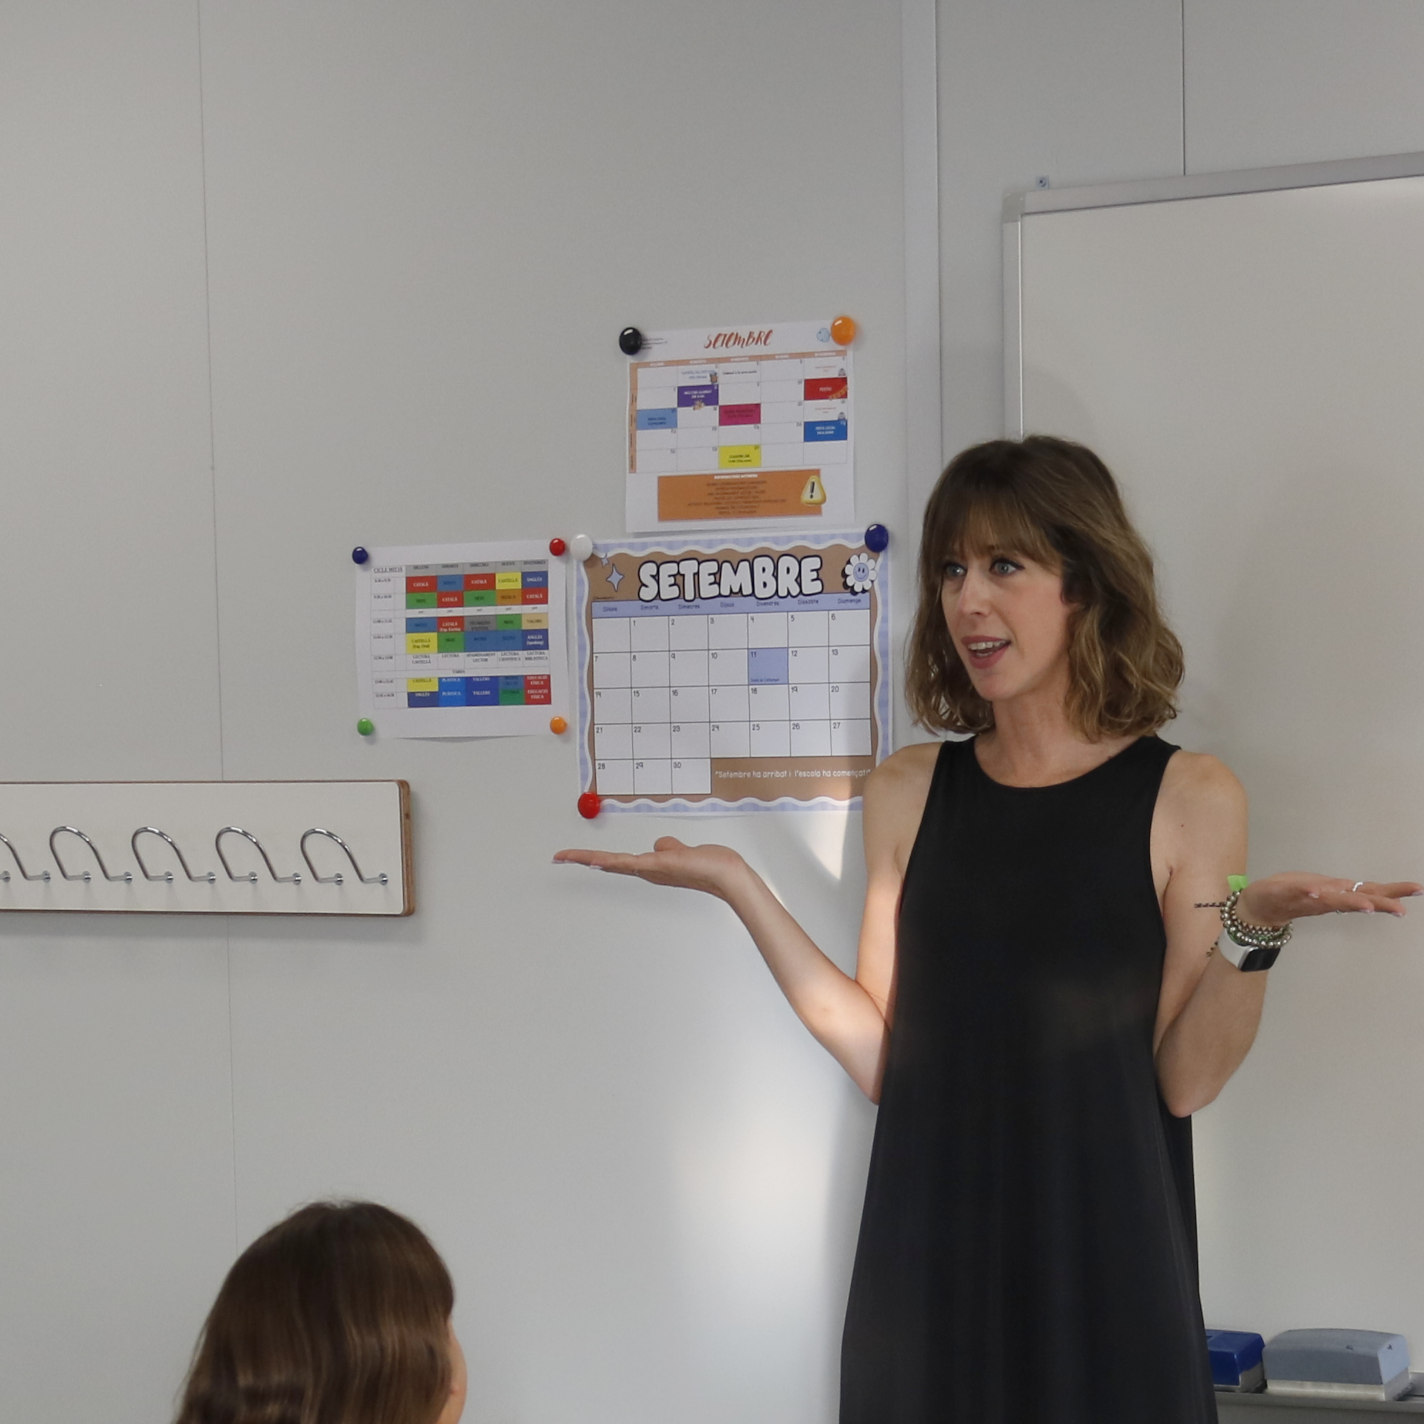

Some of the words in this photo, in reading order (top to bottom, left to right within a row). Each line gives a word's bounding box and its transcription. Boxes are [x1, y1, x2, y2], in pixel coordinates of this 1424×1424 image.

[638, 555, 824, 602] SETEMBRE
[711, 651, 719, 660] 10
[792, 649, 798, 658] 12
[832, 648, 839, 656] 13
[672, 689, 679, 697] 16
[751, 687, 758, 695] 18
[791, 685, 799, 693] 19
[831, 685, 840, 693] 20
[634, 690, 640, 698] 15
[673, 724, 681, 733] 23
[712, 724, 720, 732] 24
[752, 723, 761, 731] 25
[792, 722, 801, 731] 26
[833, 721, 841, 730] 27
[596, 726, 603, 734] 21
[634, 726, 642, 734] 22
[598, 762, 606, 770] 28
[636, 761, 644, 770] 29
[674, 761, 682, 769] 30
[752, 769, 761, 778] ha
[762, 769, 787, 778] arribat
[822, 769, 831, 777] ha
